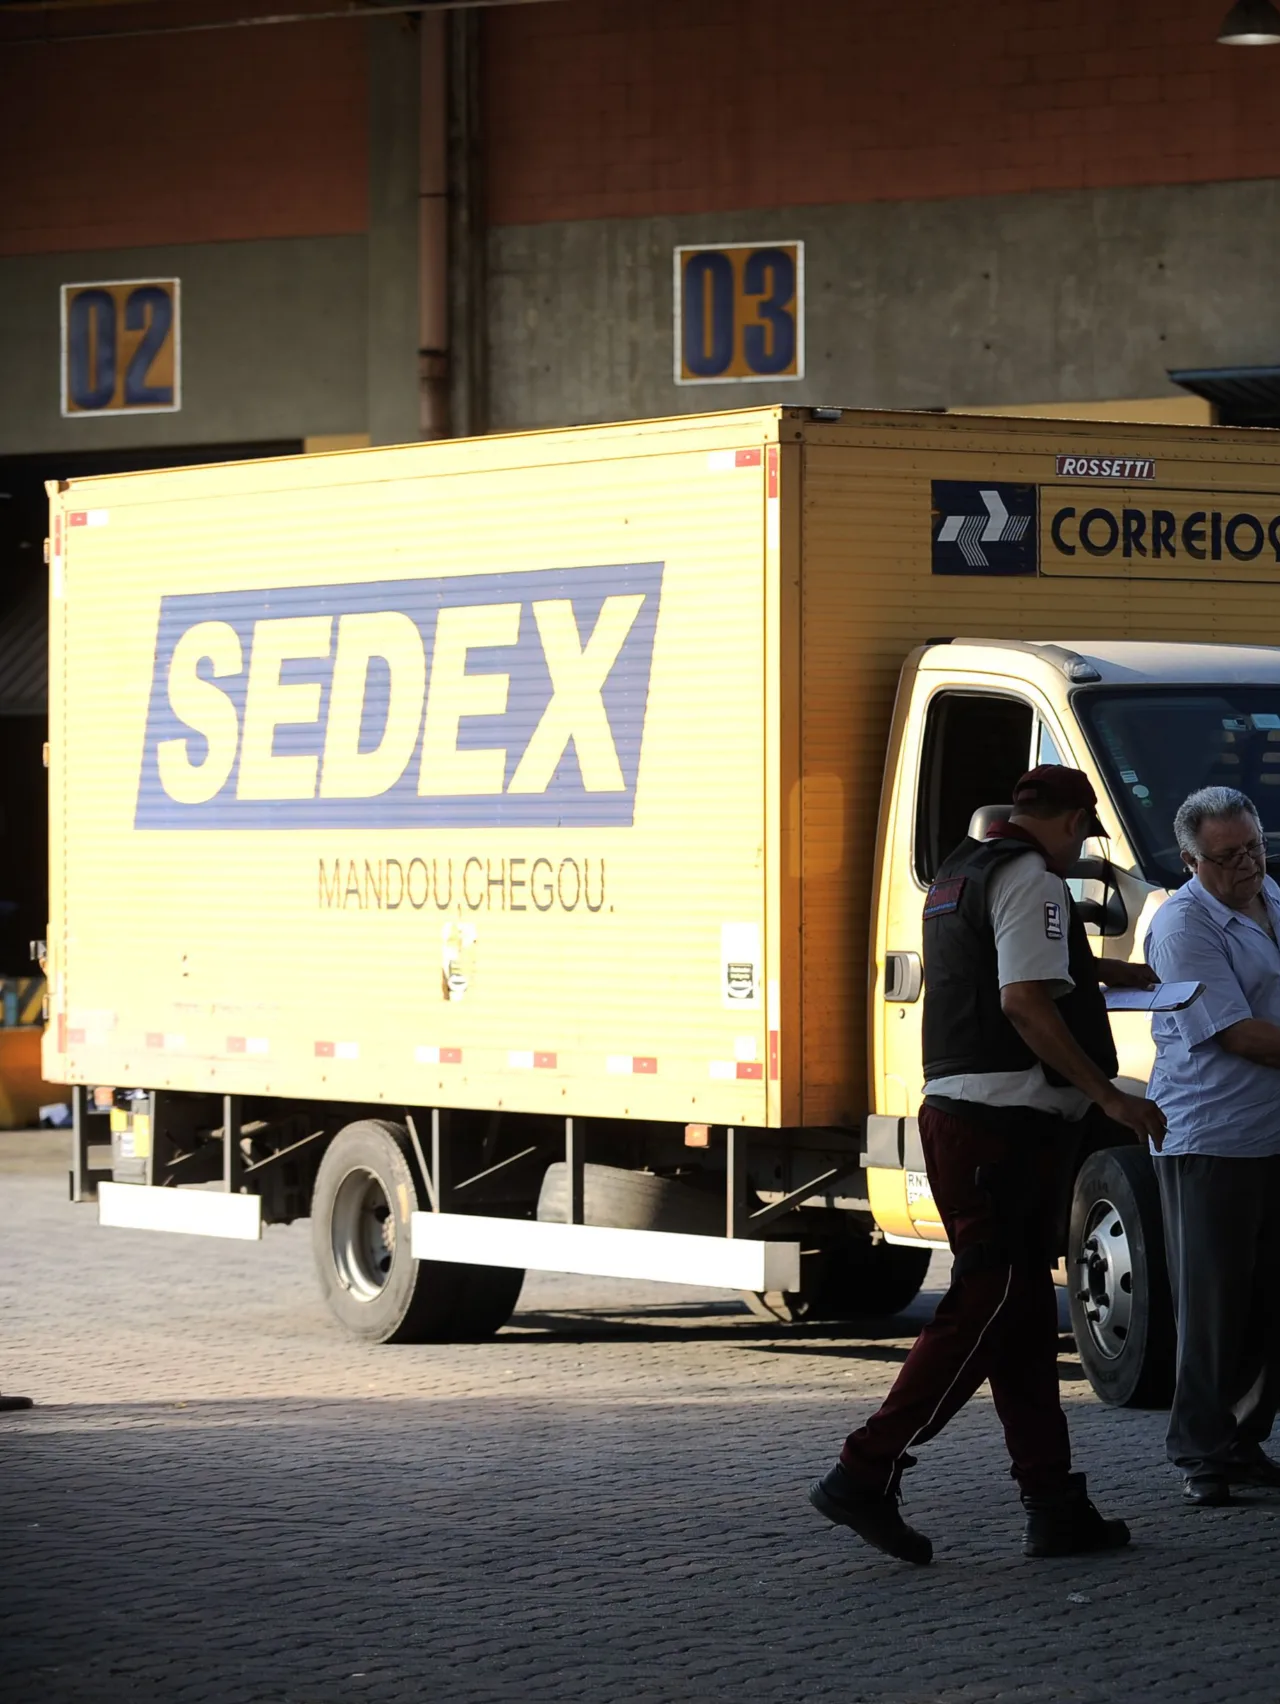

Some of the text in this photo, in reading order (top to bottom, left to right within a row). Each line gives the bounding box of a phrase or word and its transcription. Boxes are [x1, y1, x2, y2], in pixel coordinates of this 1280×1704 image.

[70, 285, 174, 410] 02
[684, 247, 794, 376] 03
[1062, 458, 1150, 478] ROSSETTI
[156, 593, 646, 804] SEDEX
